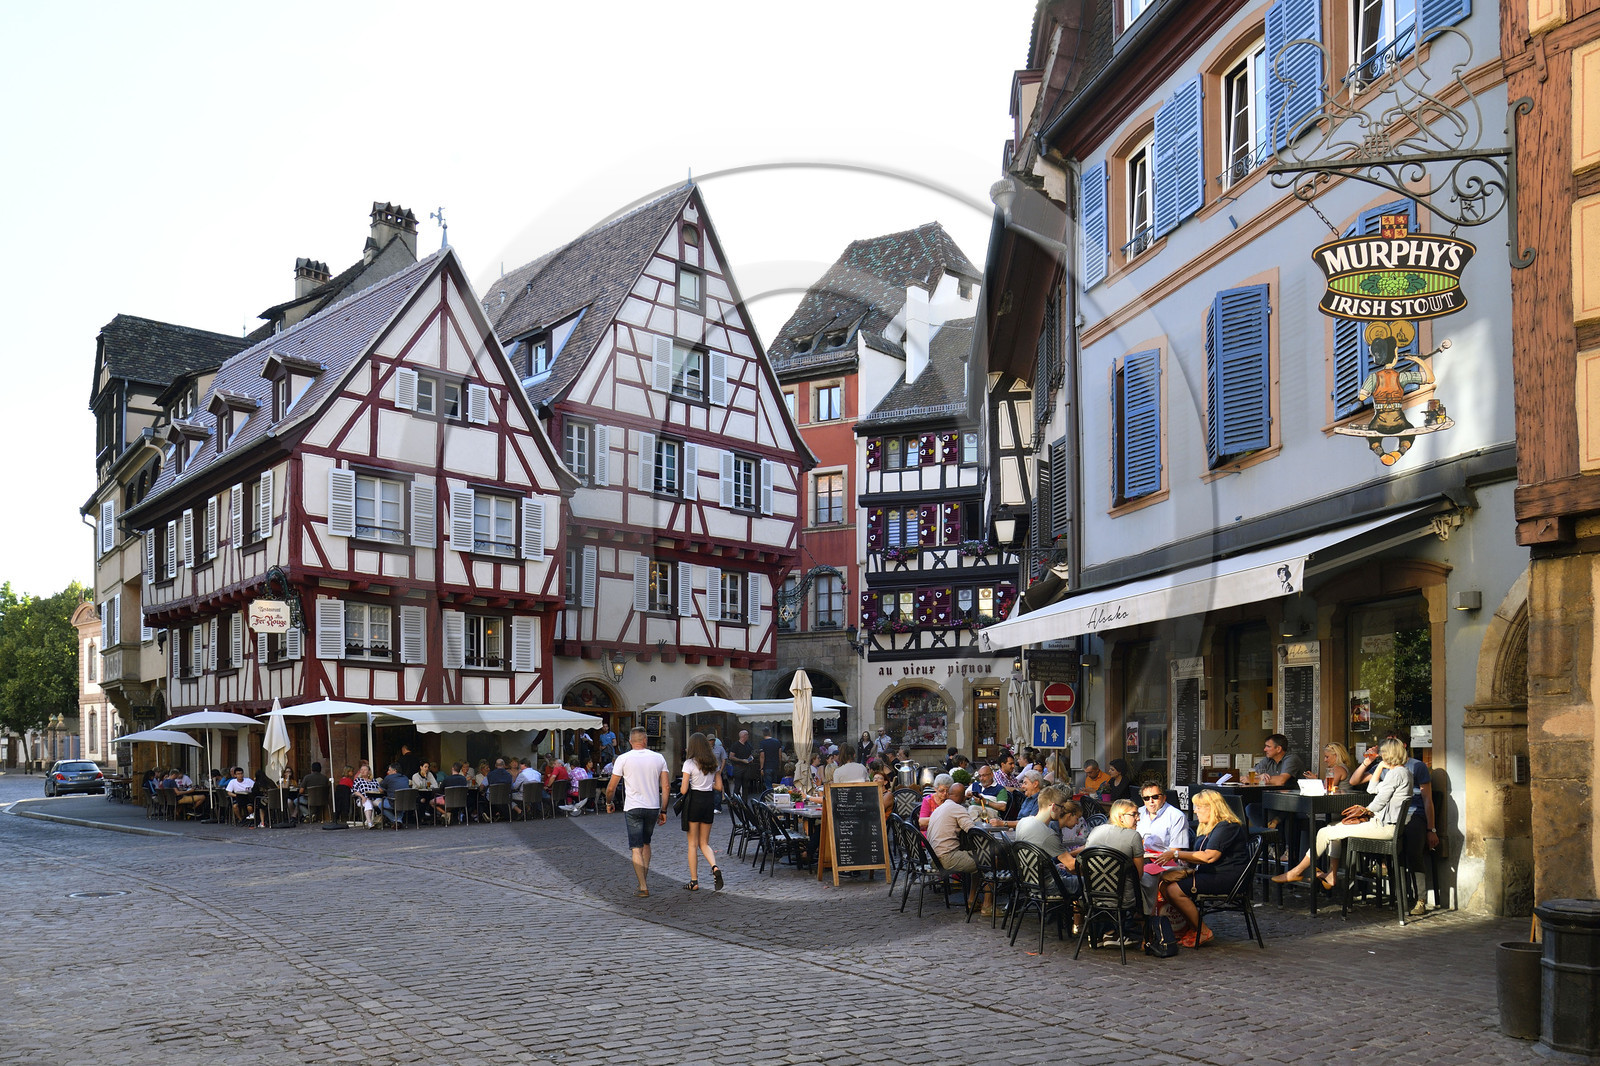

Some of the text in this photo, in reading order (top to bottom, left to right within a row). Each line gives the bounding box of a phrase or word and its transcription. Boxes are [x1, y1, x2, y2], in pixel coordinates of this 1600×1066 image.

[1322, 240, 1464, 275] MURPHY'S
[1329, 292, 1454, 316] IRISH STOUT
[250, 614, 287, 627] Fer Rouge
[1086, 605, 1129, 630] Alsako
[1289, 642, 1319, 659] Alsako
[878, 661, 992, 677] au vieux pignon
